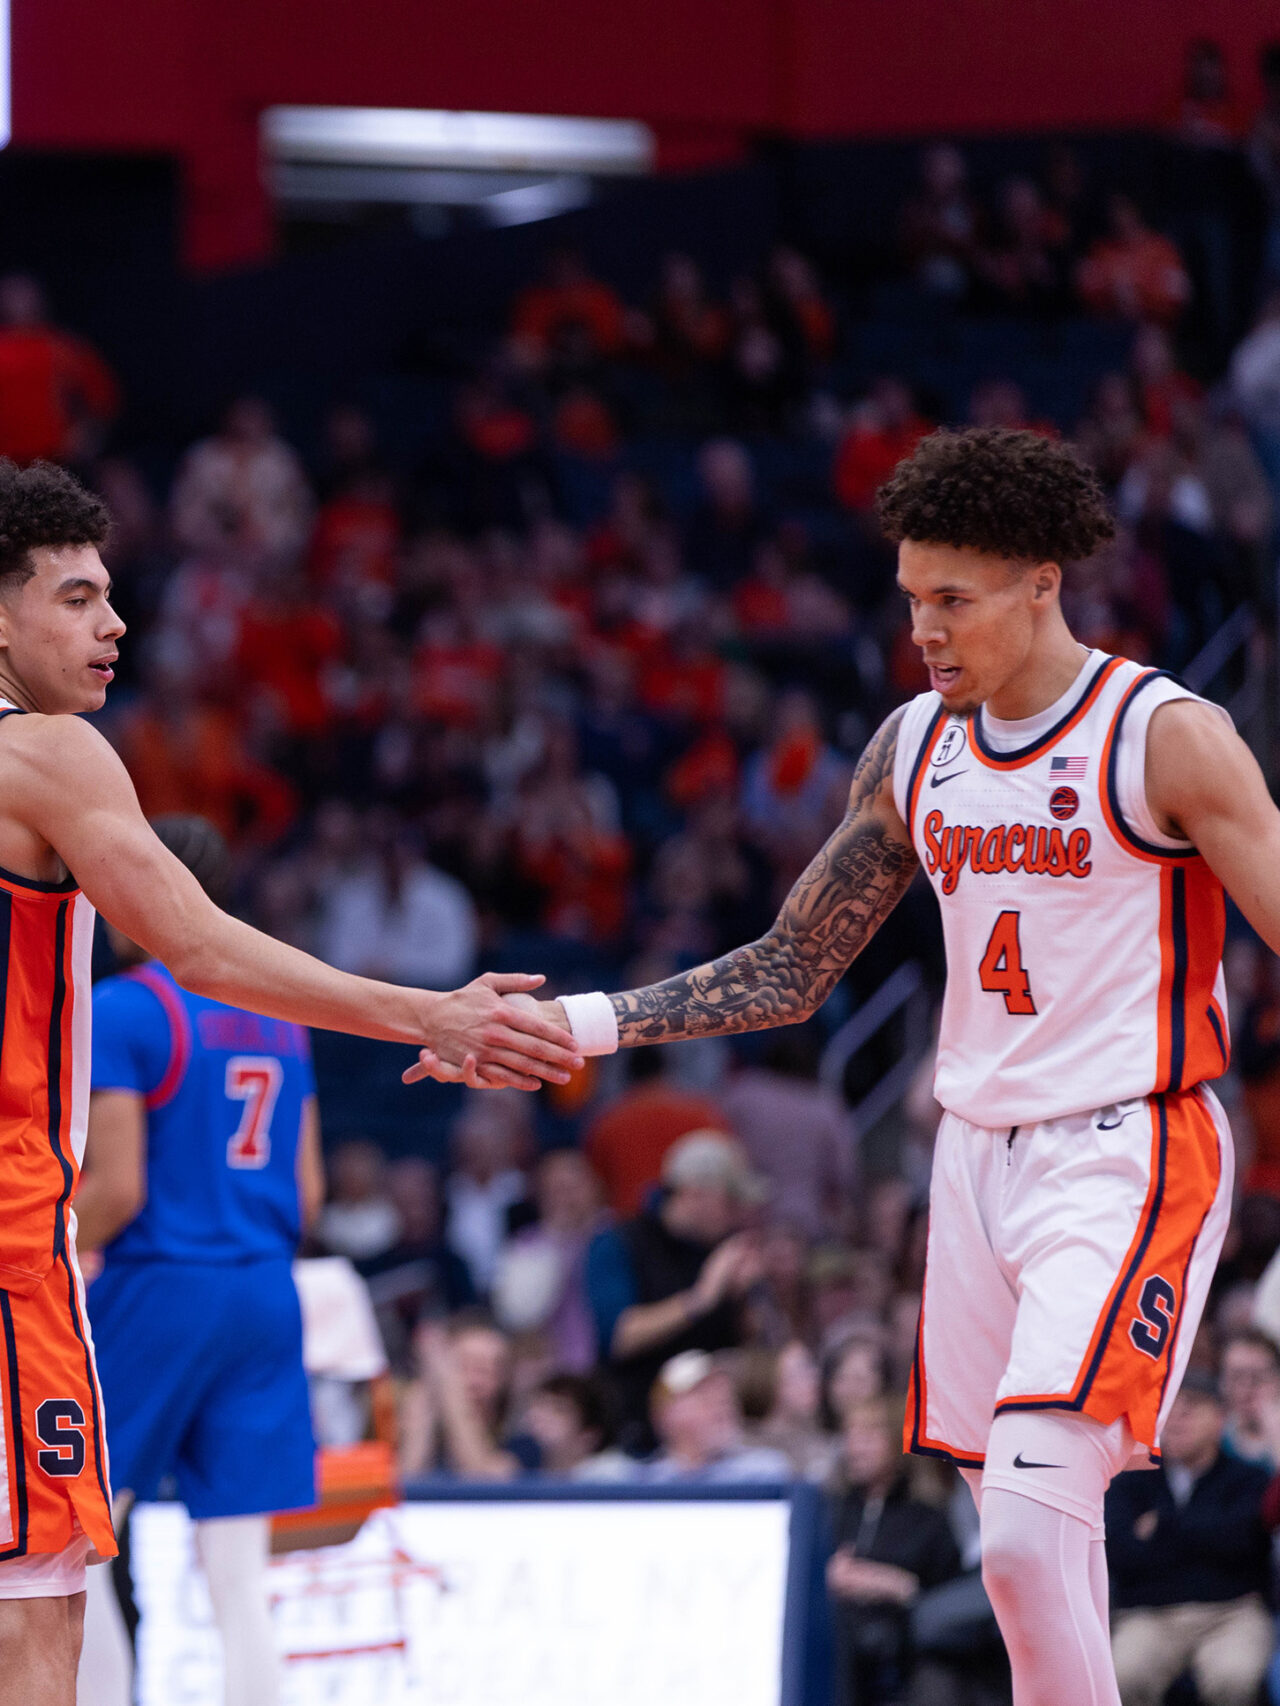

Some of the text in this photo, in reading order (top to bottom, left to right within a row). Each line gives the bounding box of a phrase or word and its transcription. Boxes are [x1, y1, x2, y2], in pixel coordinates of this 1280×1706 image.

[923, 810, 1092, 895] Syracuse
[978, 910, 1038, 1015] 4
[224, 1055, 284, 1170] 7
[1128, 1273, 1176, 1362] S
[35, 1398, 87, 1477] S
